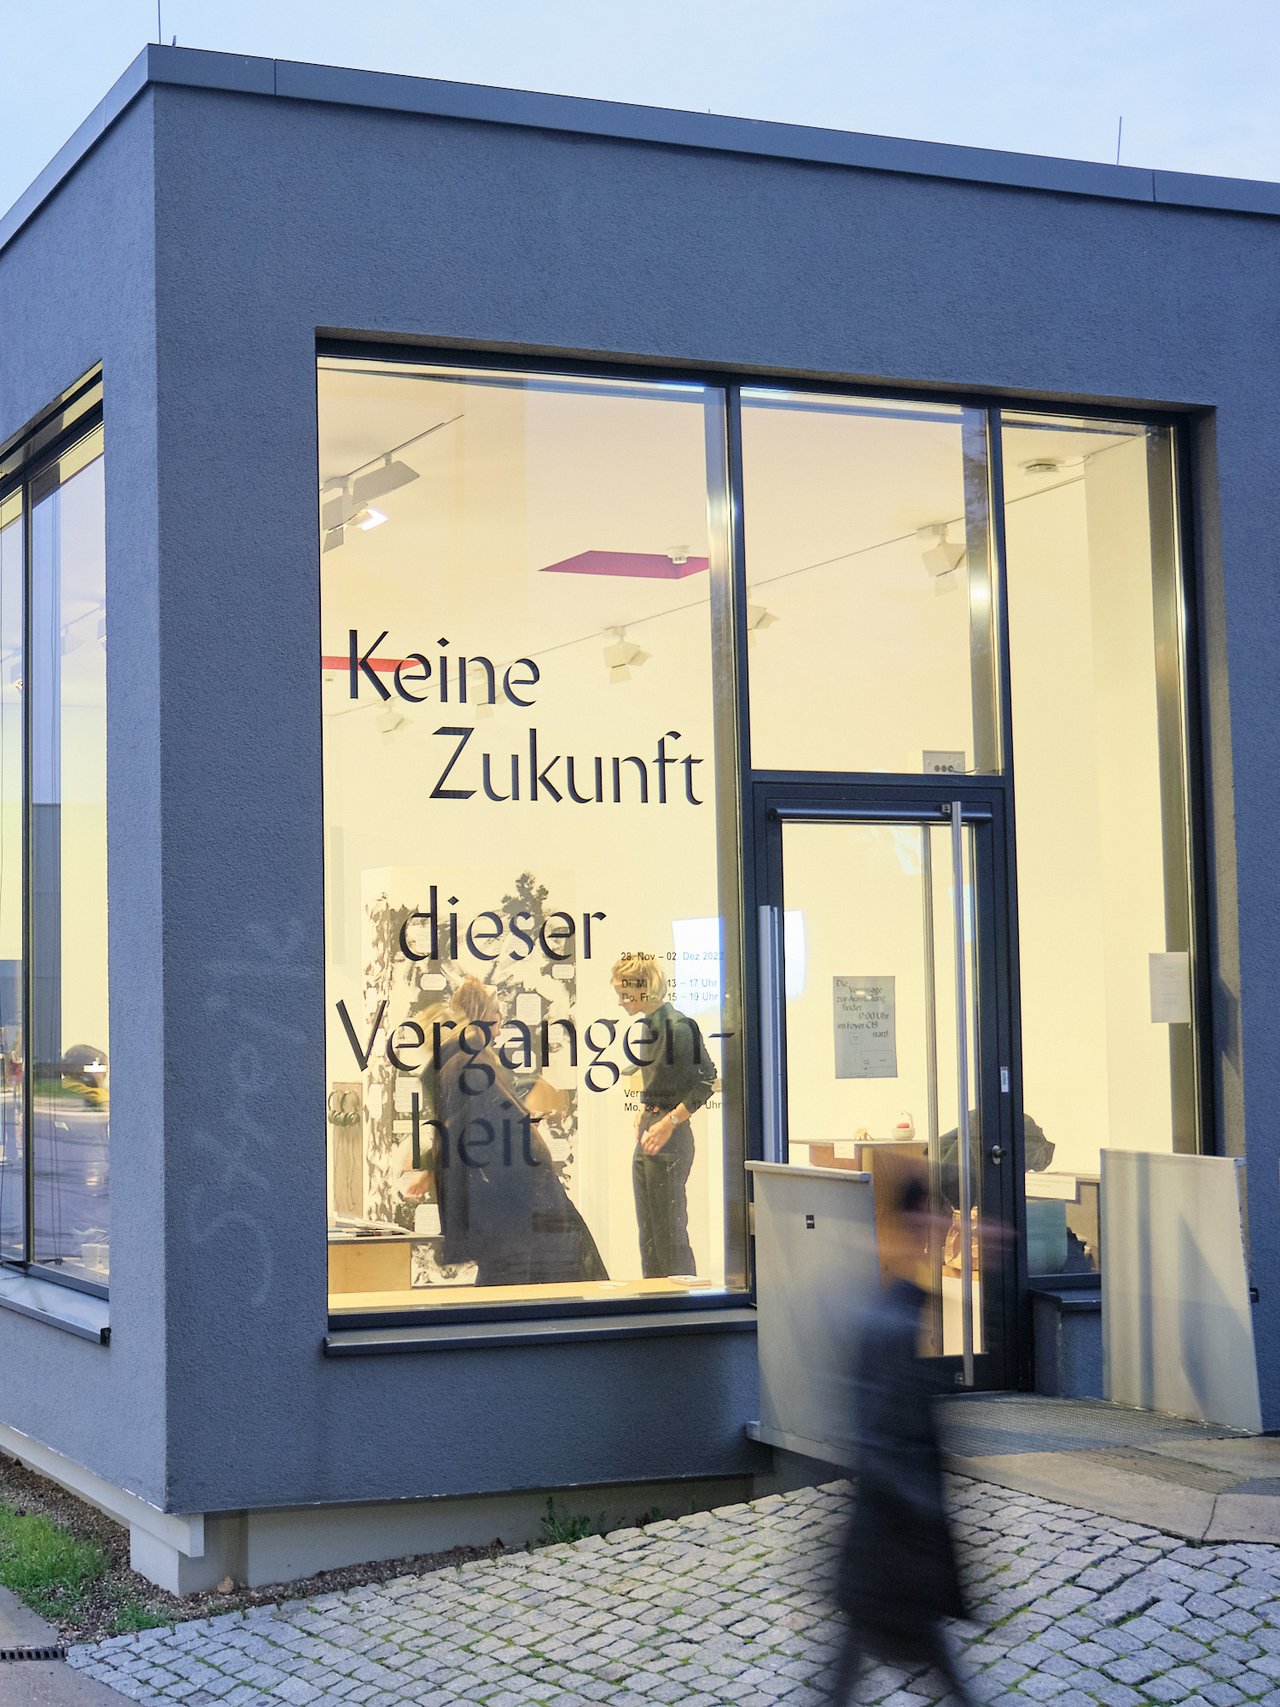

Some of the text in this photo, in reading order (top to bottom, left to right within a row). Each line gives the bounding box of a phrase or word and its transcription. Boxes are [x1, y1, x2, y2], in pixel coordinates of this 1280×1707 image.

[349, 629, 540, 707] Keine
[429, 726, 704, 806] Zukunft
[398, 885, 608, 962] dieser
[637, 952, 656, 961] Nov
[667, 979, 677, 988] 13
[689, 979, 698, 988] 17
[701, 979, 718, 988] Uhr
[668, 992, 678, 1001] 15
[690, 992, 699, 1001] 19
[702, 992, 719, 1001] Uhr
[848, 995, 886, 1004] Ausstlung
[336, 999, 736, 1093] Vergangen-
[705, 1101, 722, 1110] Uhr
[412, 1092, 544, 1170] heit
